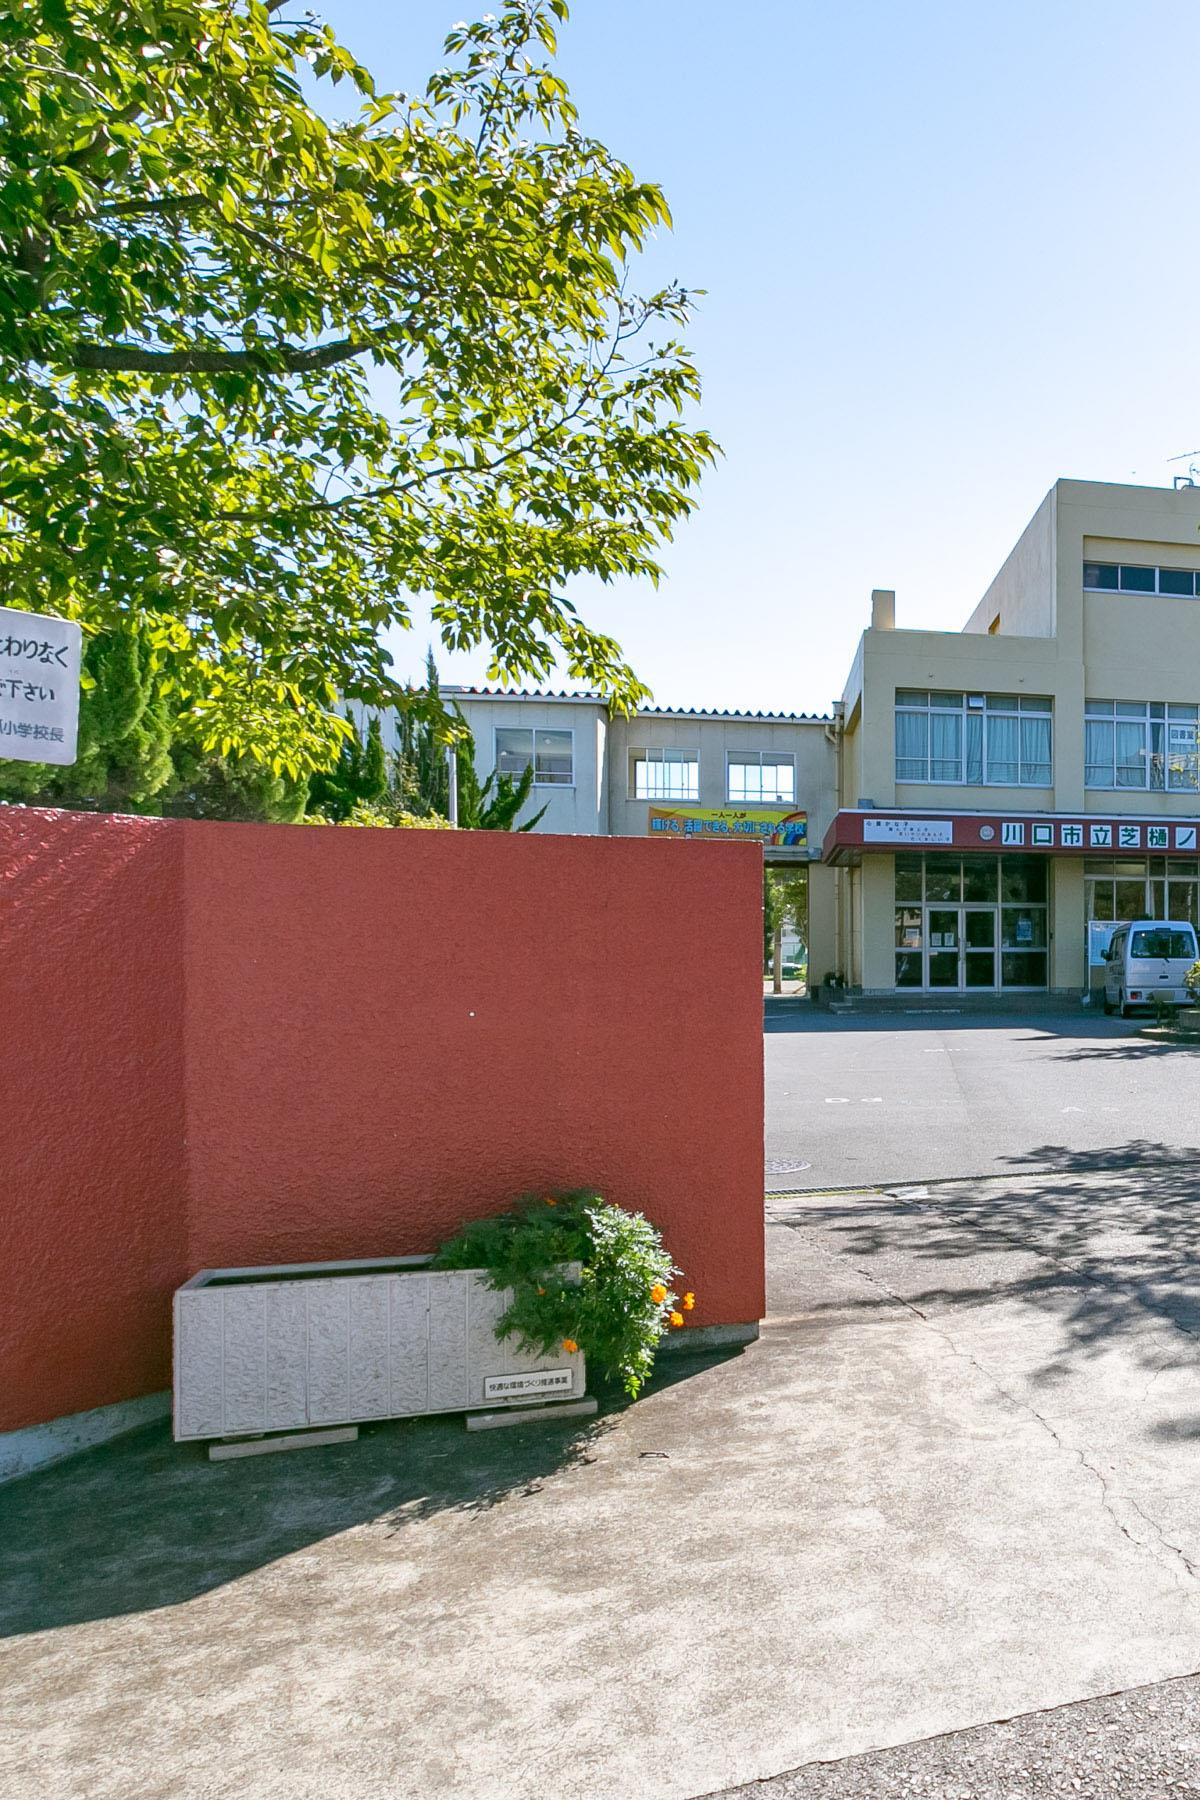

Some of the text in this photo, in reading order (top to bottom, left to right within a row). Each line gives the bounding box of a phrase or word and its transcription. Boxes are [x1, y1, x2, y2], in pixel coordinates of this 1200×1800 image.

[711, 811, 747, 820] 一人一人が
